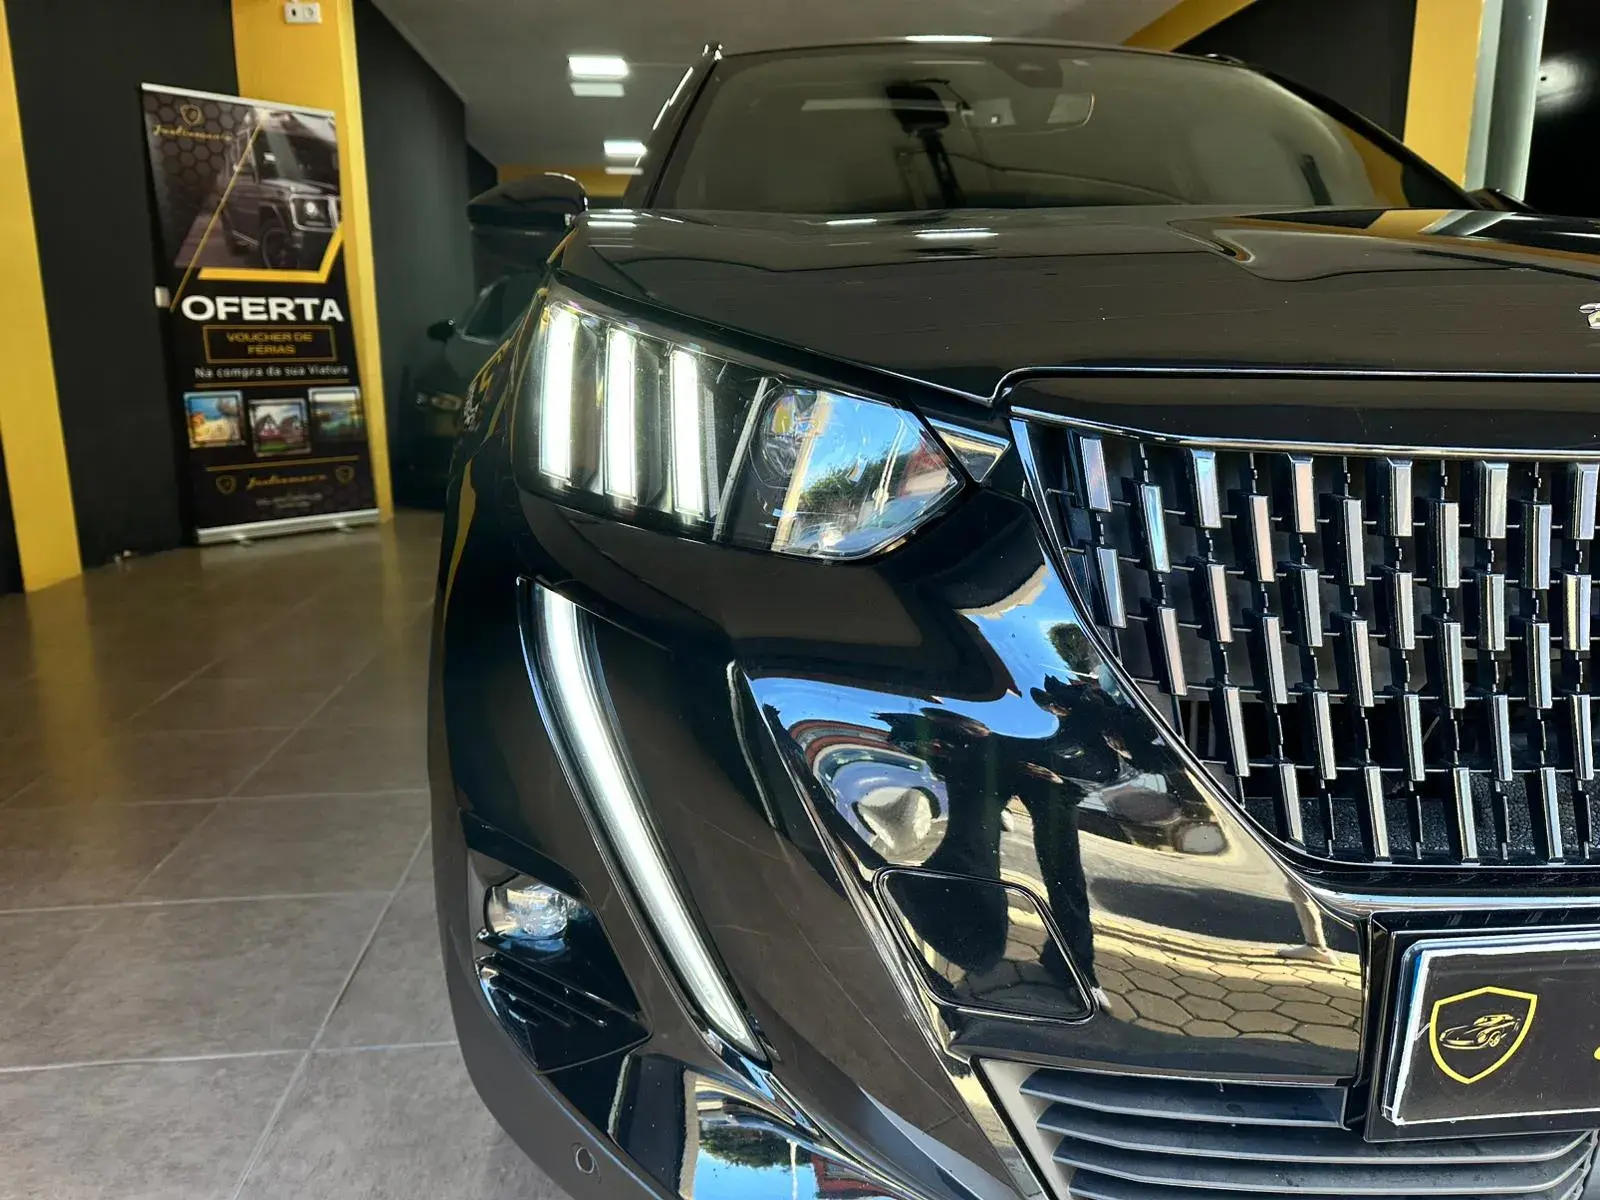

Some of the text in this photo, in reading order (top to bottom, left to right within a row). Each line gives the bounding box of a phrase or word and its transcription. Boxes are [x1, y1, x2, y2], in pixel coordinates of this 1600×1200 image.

[181, 295, 344, 322] OFERTA
[226, 331, 313, 343] VOUCHER DE
[194, 365, 349, 379] Na compra da sua Viatura
